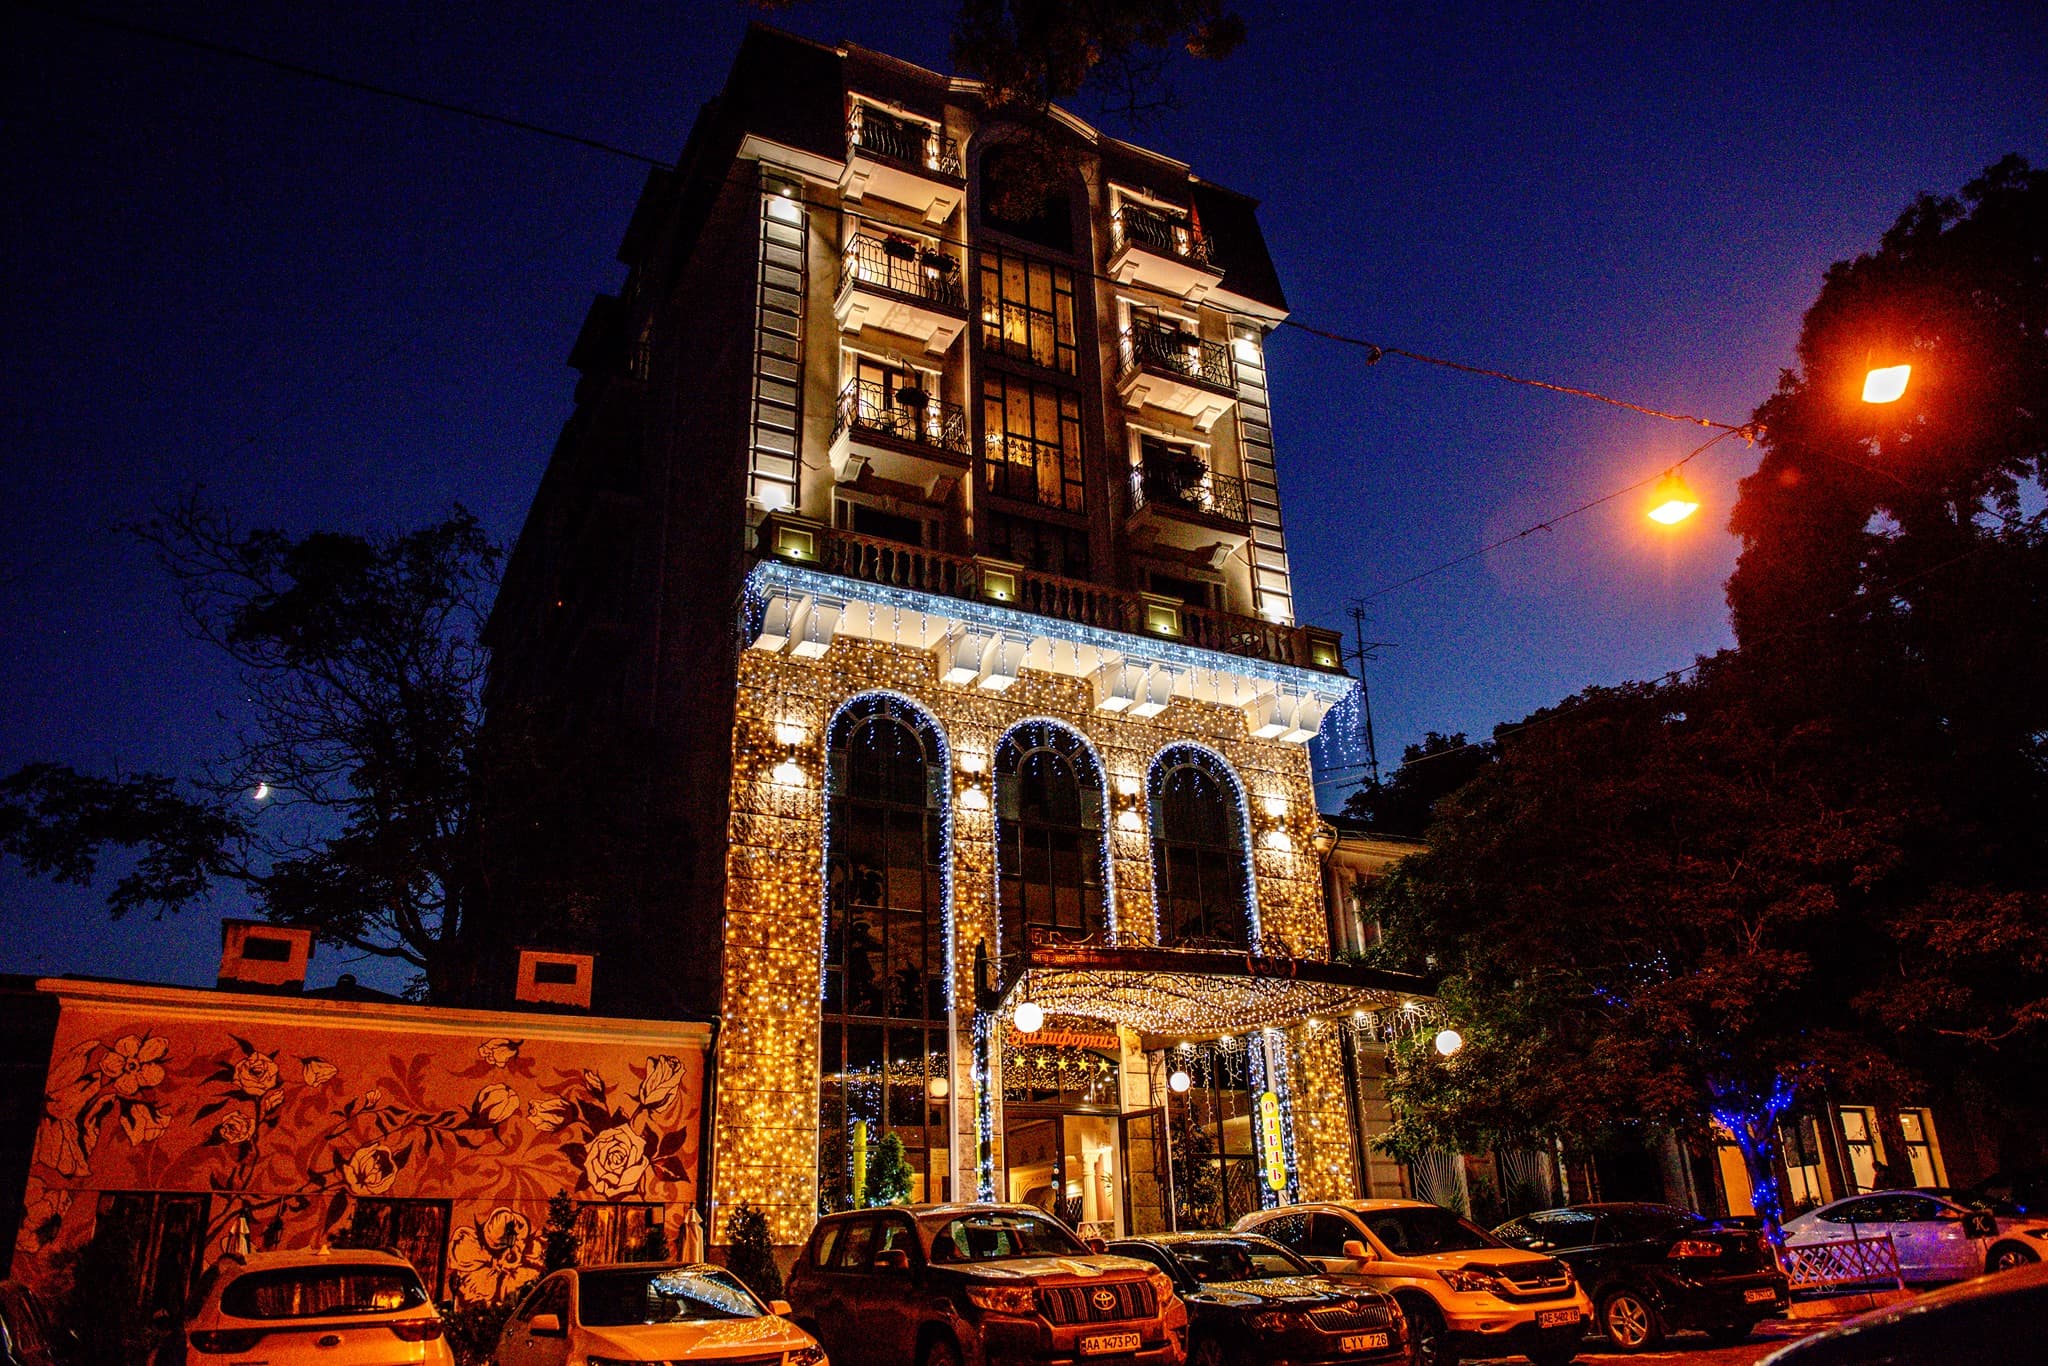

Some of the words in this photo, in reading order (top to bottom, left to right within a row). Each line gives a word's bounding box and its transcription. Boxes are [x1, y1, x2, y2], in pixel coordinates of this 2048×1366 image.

[1265, 1102, 1282, 1181] ОТЕЛЬ
[1087, 1339, 1100, 1350] AA
[1343, 1337, 1363, 1349] LYY
[1370, 1334, 1387, 1346] 726
